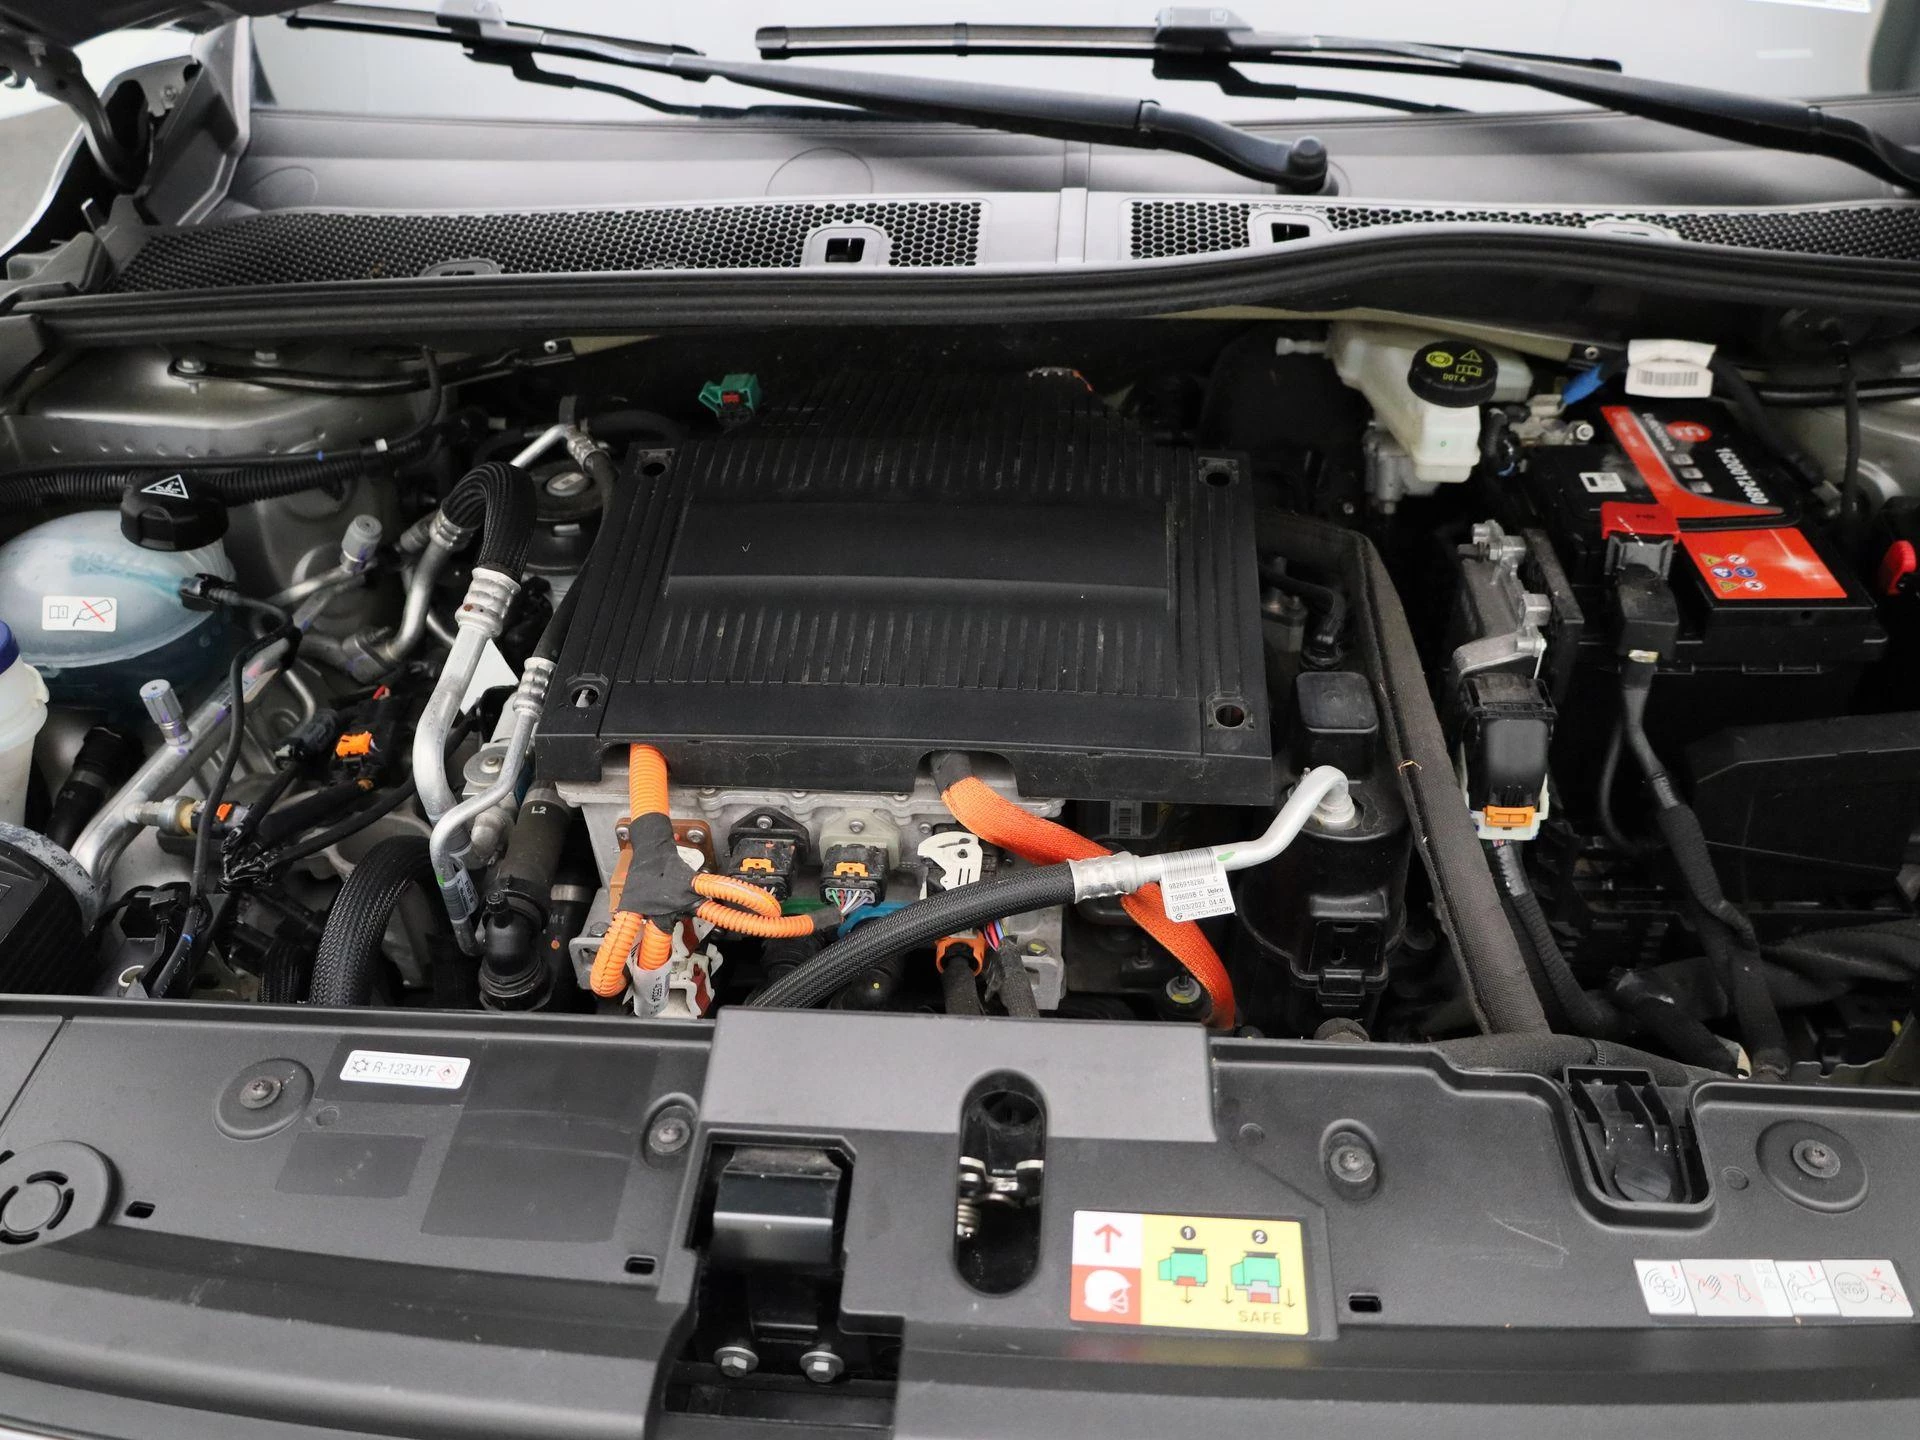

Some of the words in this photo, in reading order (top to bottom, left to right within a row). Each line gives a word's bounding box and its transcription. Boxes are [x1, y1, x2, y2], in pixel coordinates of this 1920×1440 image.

[531, 806, 547, 814] L2
[1182, 1226, 1194, 1240] 1
[1254, 1230, 1266, 1244] 2
[1238, 1310, 1282, 1325] SAFE
